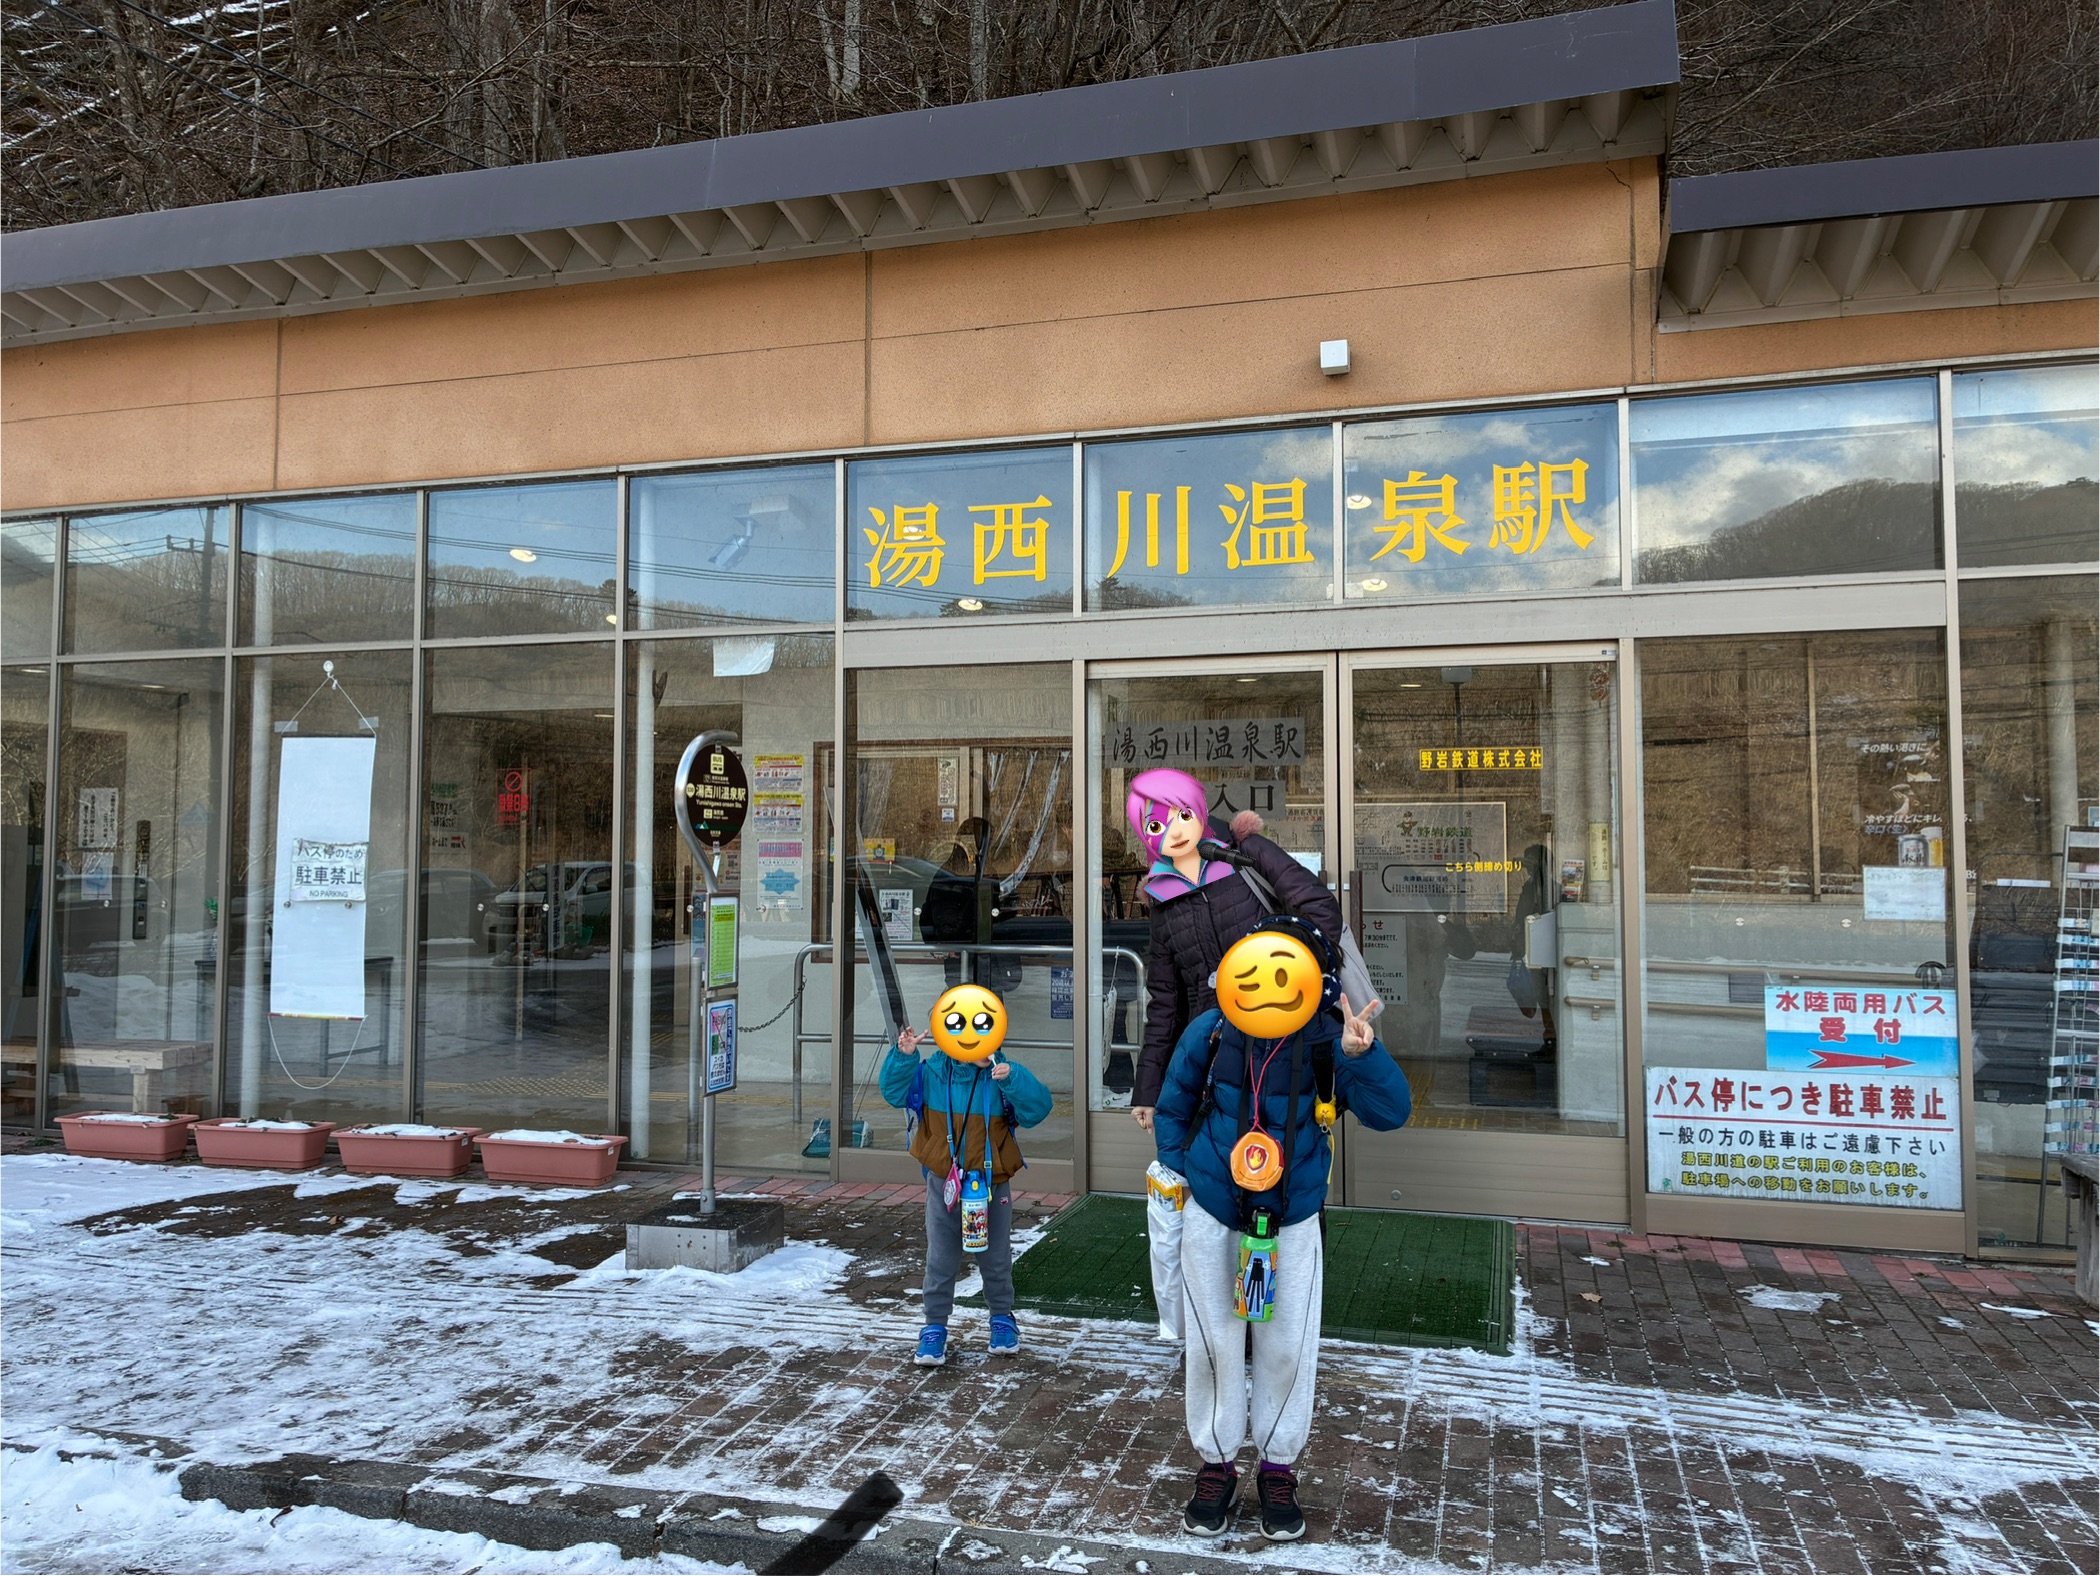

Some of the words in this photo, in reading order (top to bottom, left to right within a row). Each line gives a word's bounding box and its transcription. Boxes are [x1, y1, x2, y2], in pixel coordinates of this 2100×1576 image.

[863, 457, 1595, 589] 湯西川温泉駅
[1114, 721, 1302, 763] 湯西川温泉駅
[1421, 749, 1542, 769] 野岩鉄道株式会社
[695, 784, 746, 801] 湯西川温泉駅
[1208, 783, 1275, 814] 入口
[1417, 826, 1473, 838] 野岩鉄道
[294, 865, 363, 885] 駐車禁止
[1445, 861, 1522, 873] こちら側締め切り
[309, 890, 320, 898] NO
[320, 890, 349, 898] PARKING
[1775, 990, 1947, 1015] 水陸両用バス
[1654, 1075, 1947, 1121] バス停につき駐車禁止
[1658, 1125, 1946, 1156] 一般の方の駐車はご遠慮下さい
[1681, 1151, 1928, 1180] 湯西川道の駅ご利用のお客様は、
[1681, 1172, 1929, 1200] 駐車場への移動をお願いします。
